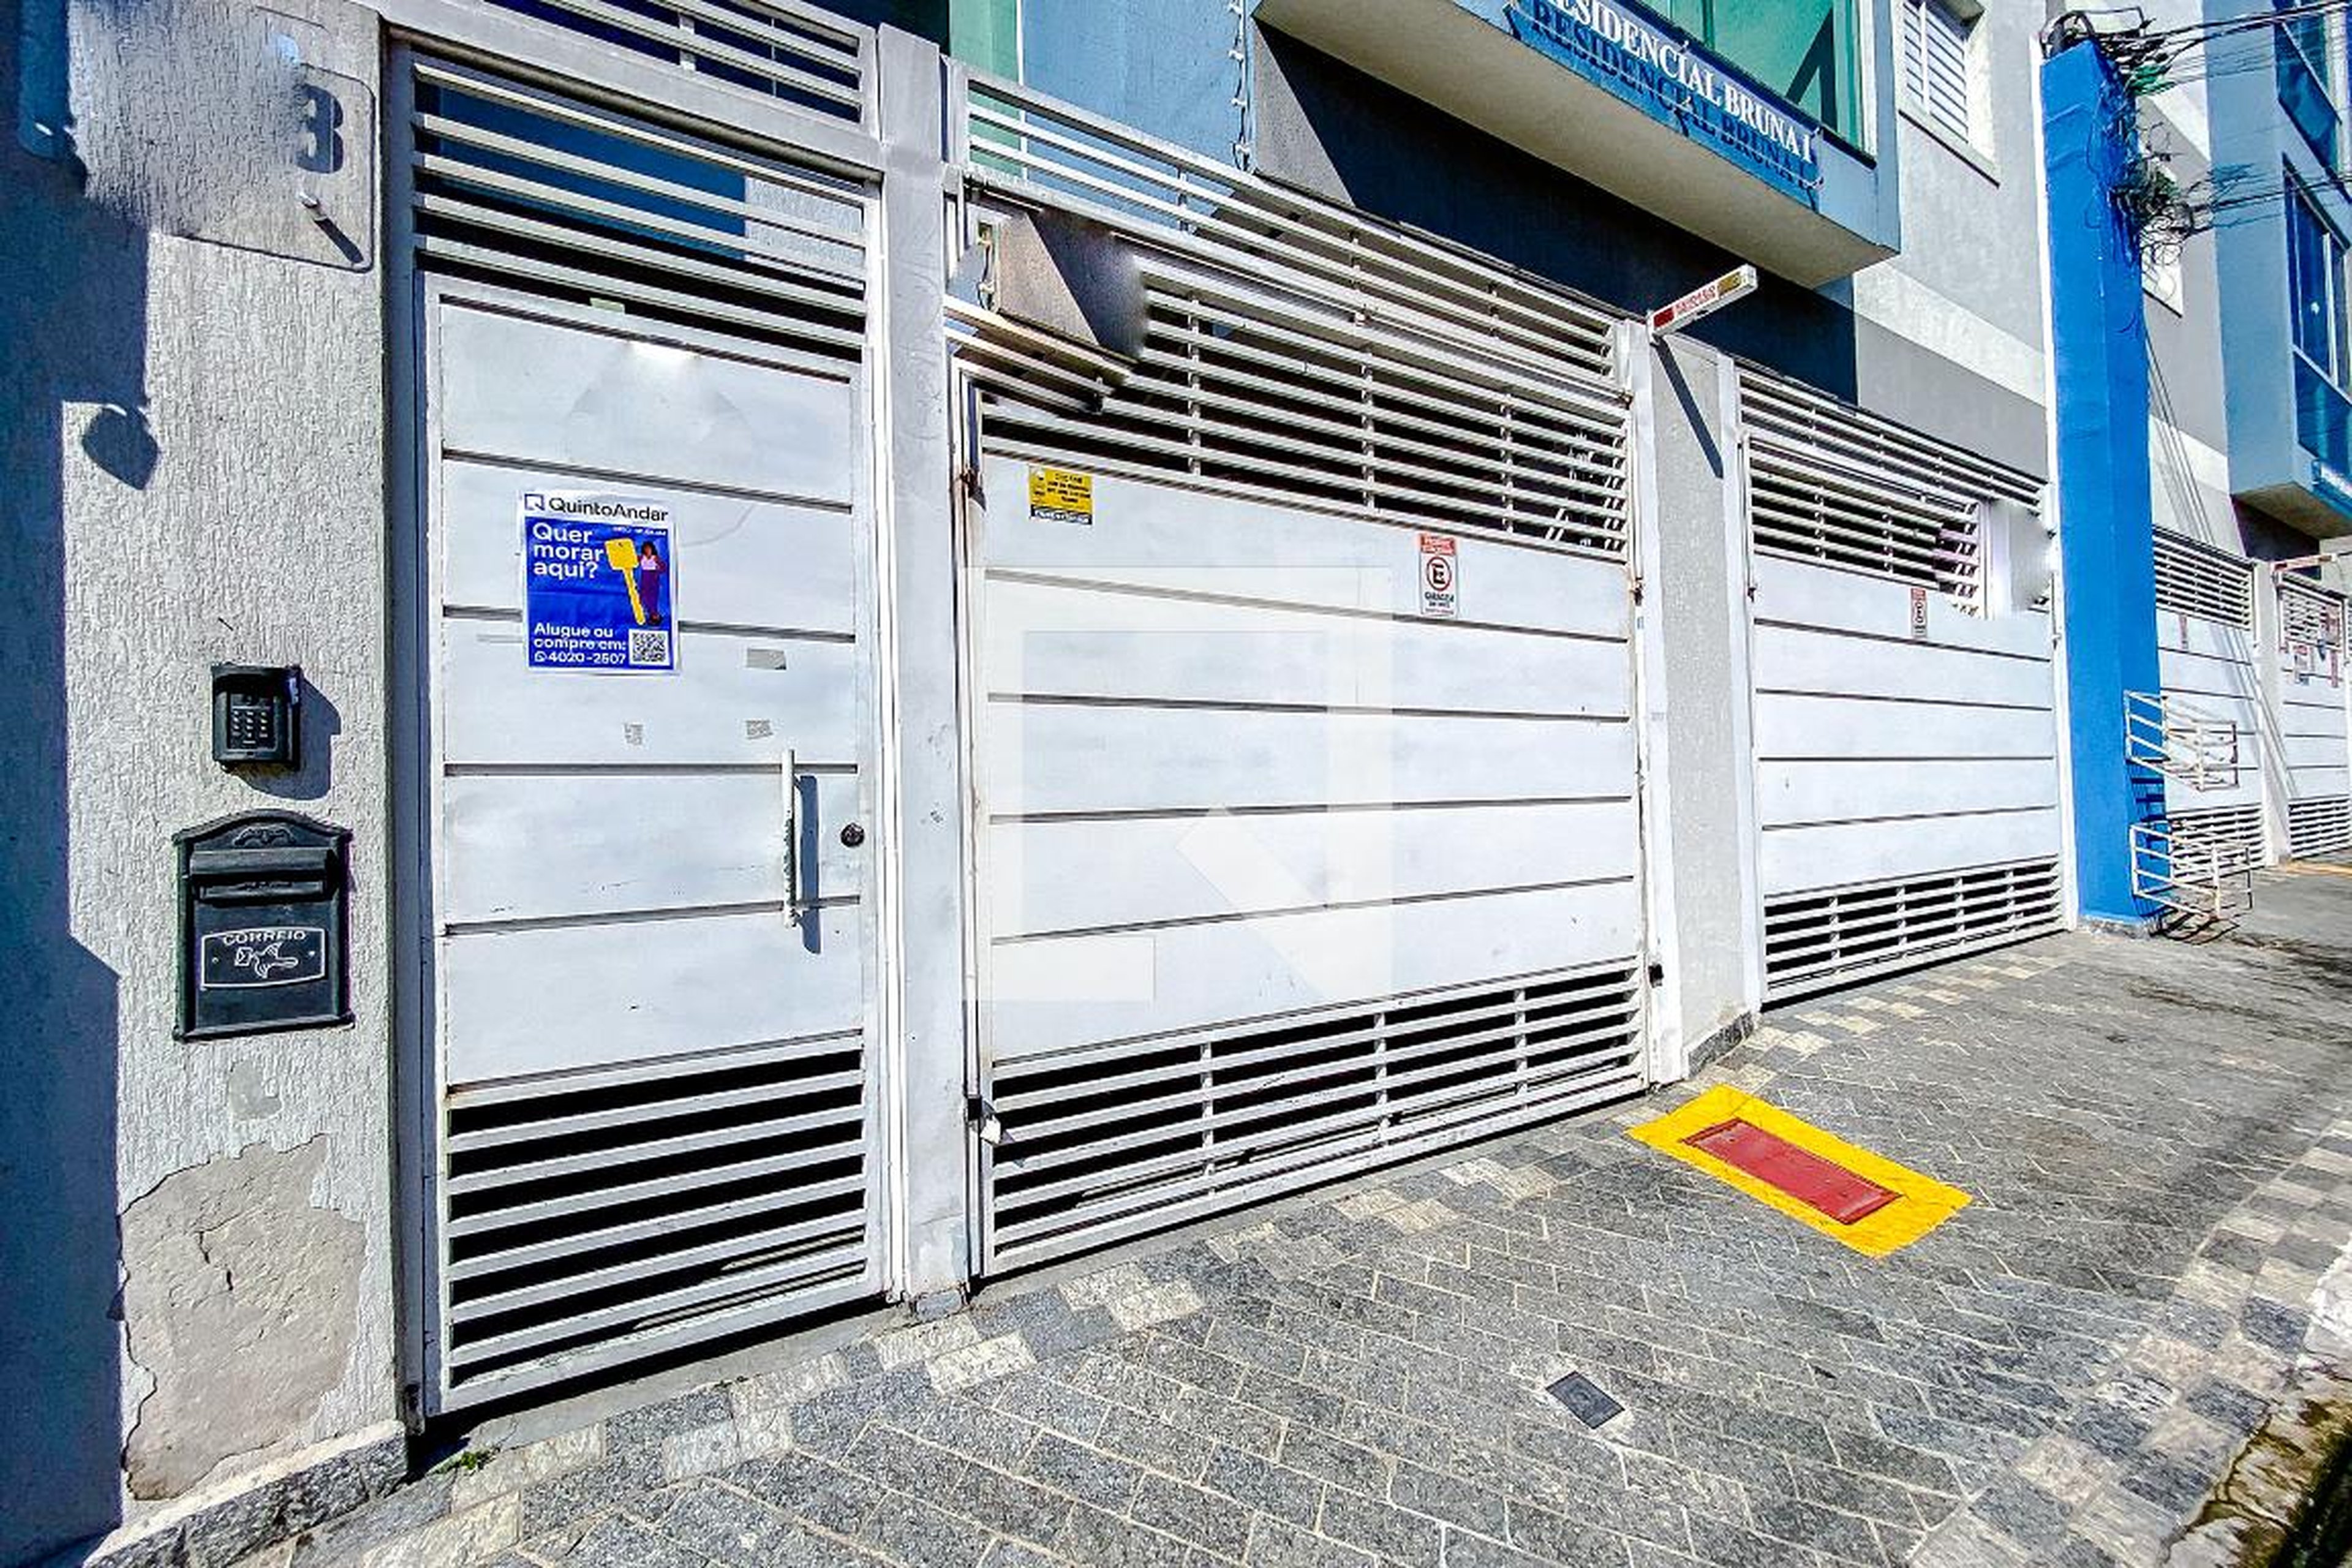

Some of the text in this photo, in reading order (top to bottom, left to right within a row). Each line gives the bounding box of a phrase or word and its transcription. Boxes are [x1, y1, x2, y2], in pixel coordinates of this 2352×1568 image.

[549, 497, 669, 521] QuintoAndar
[532, 522, 593, 544] Quer
[533, 544, 604, 562] morar
[533, 561, 598, 581] aqui?
[534, 622, 613, 638] Alugue ou
[223, 930, 307, 946] CORREIO
